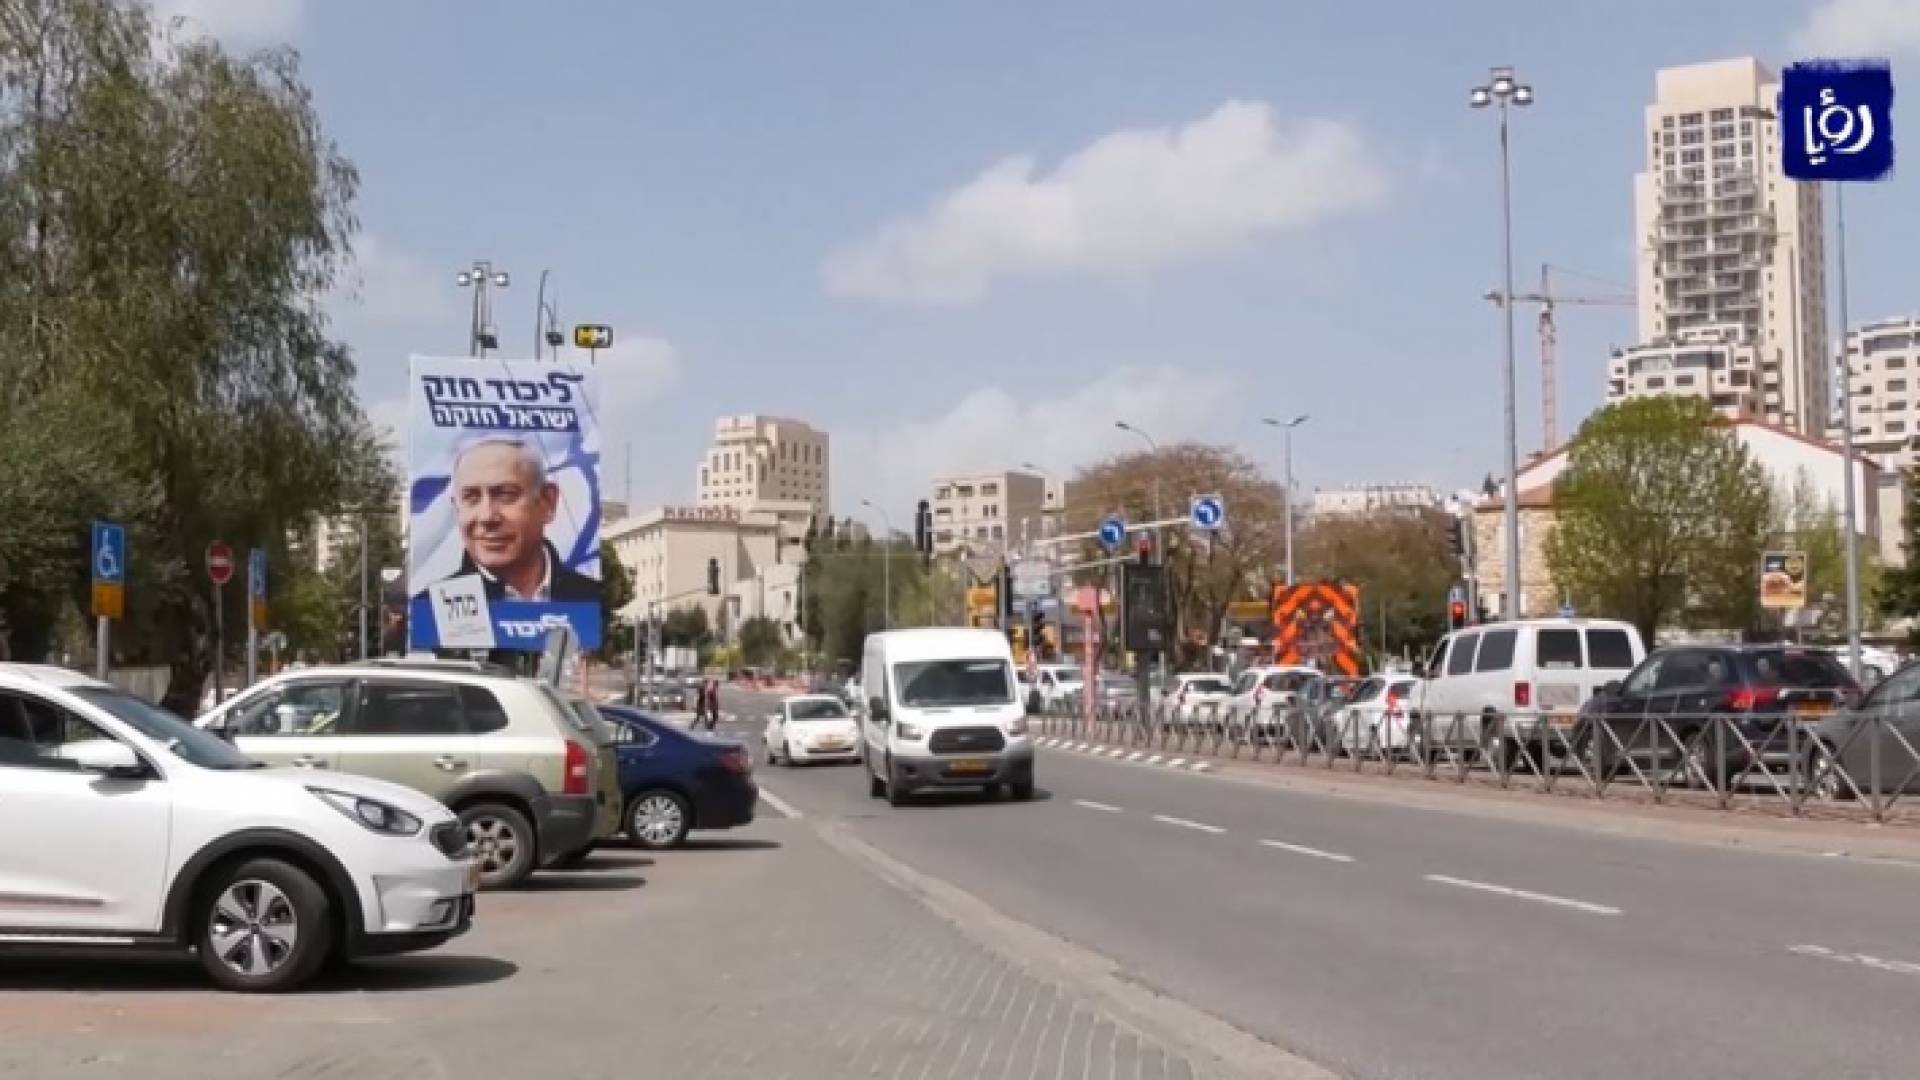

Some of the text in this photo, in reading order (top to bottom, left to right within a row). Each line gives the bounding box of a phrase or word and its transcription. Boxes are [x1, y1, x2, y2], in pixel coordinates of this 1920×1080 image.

[421, 372, 583, 406] ליכוד חזק
[433, 403, 575, 431] ישראל חזקה
